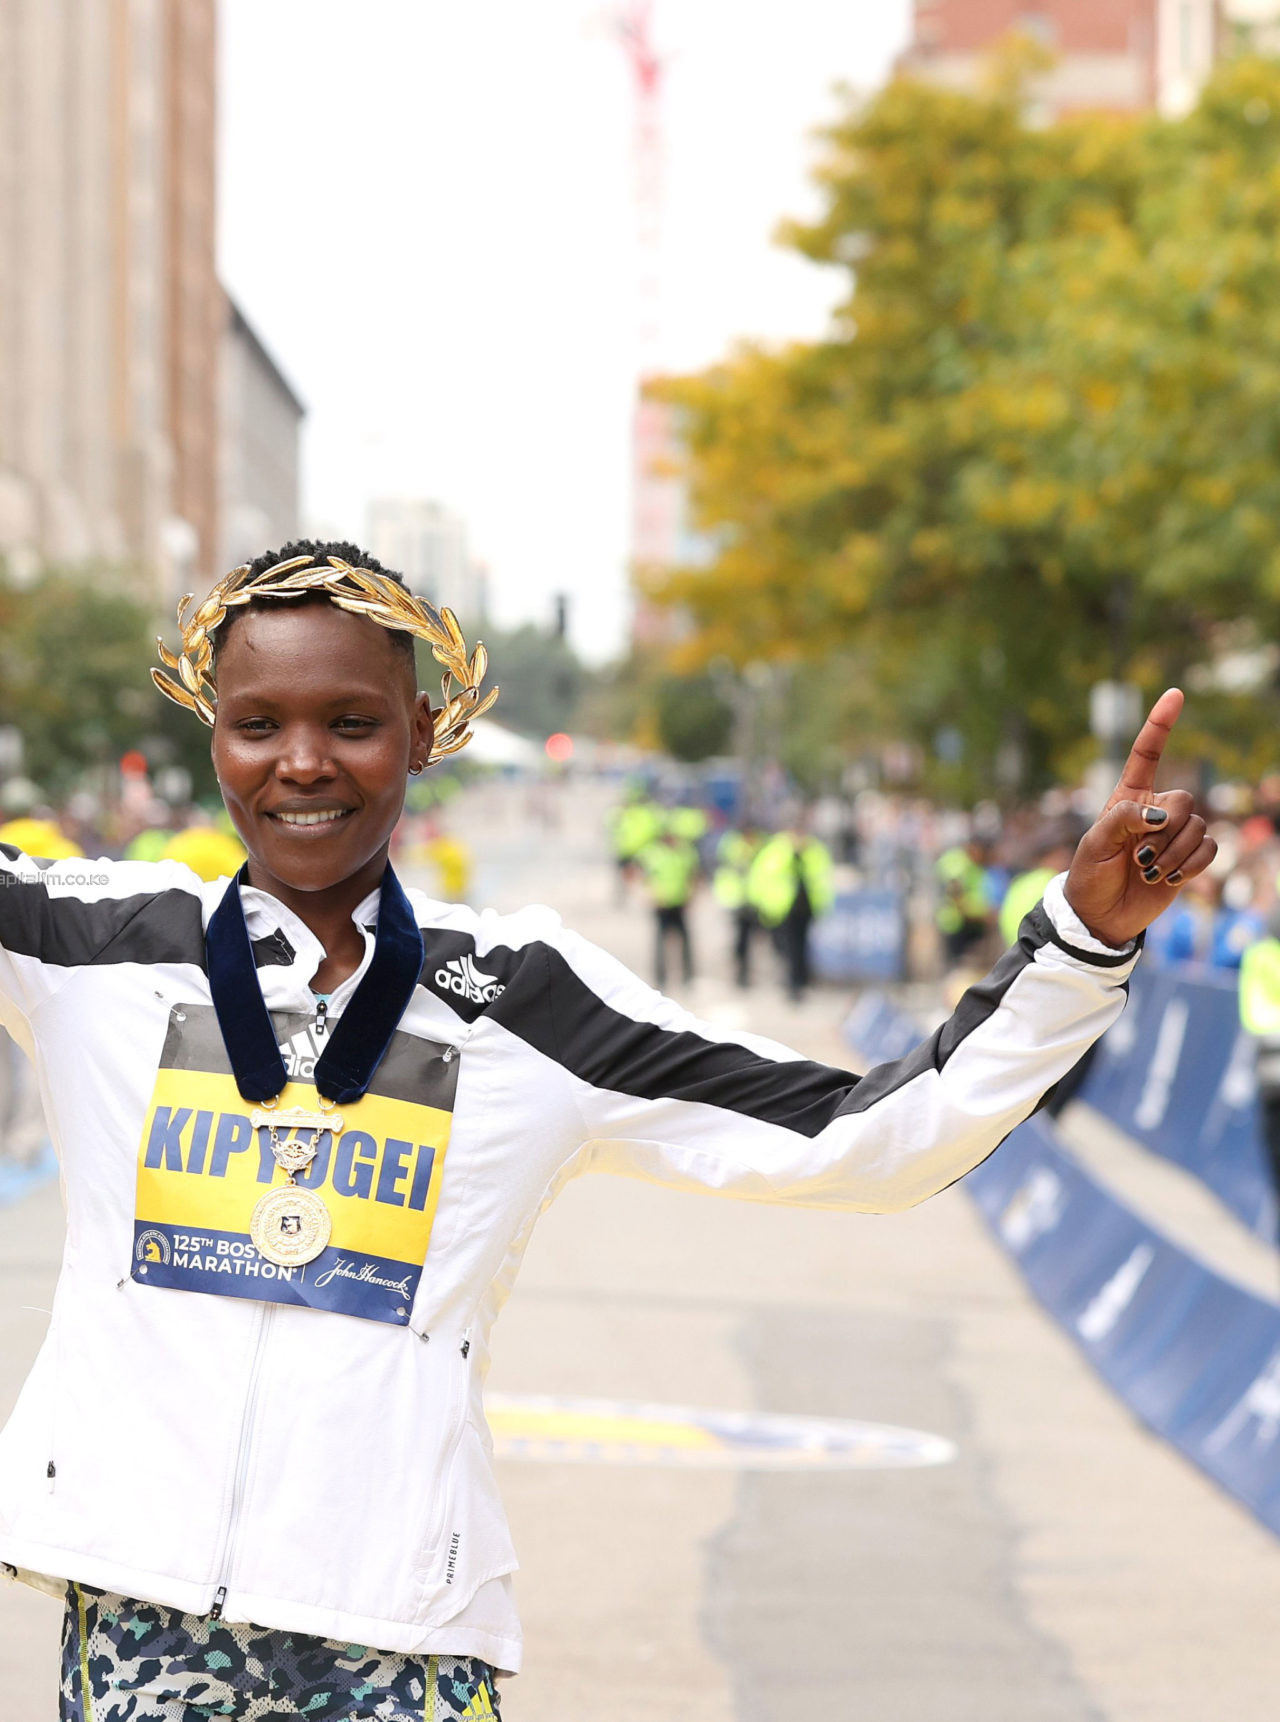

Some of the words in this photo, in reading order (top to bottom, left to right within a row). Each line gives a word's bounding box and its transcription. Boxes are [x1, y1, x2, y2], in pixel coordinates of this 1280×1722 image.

[173, 1234, 213, 1252] 125TH
[216, 1239, 263, 1260] BOS
[172, 1252, 293, 1282] MARATHON
[446, 1532, 460, 1585] PRIMEBLUE
